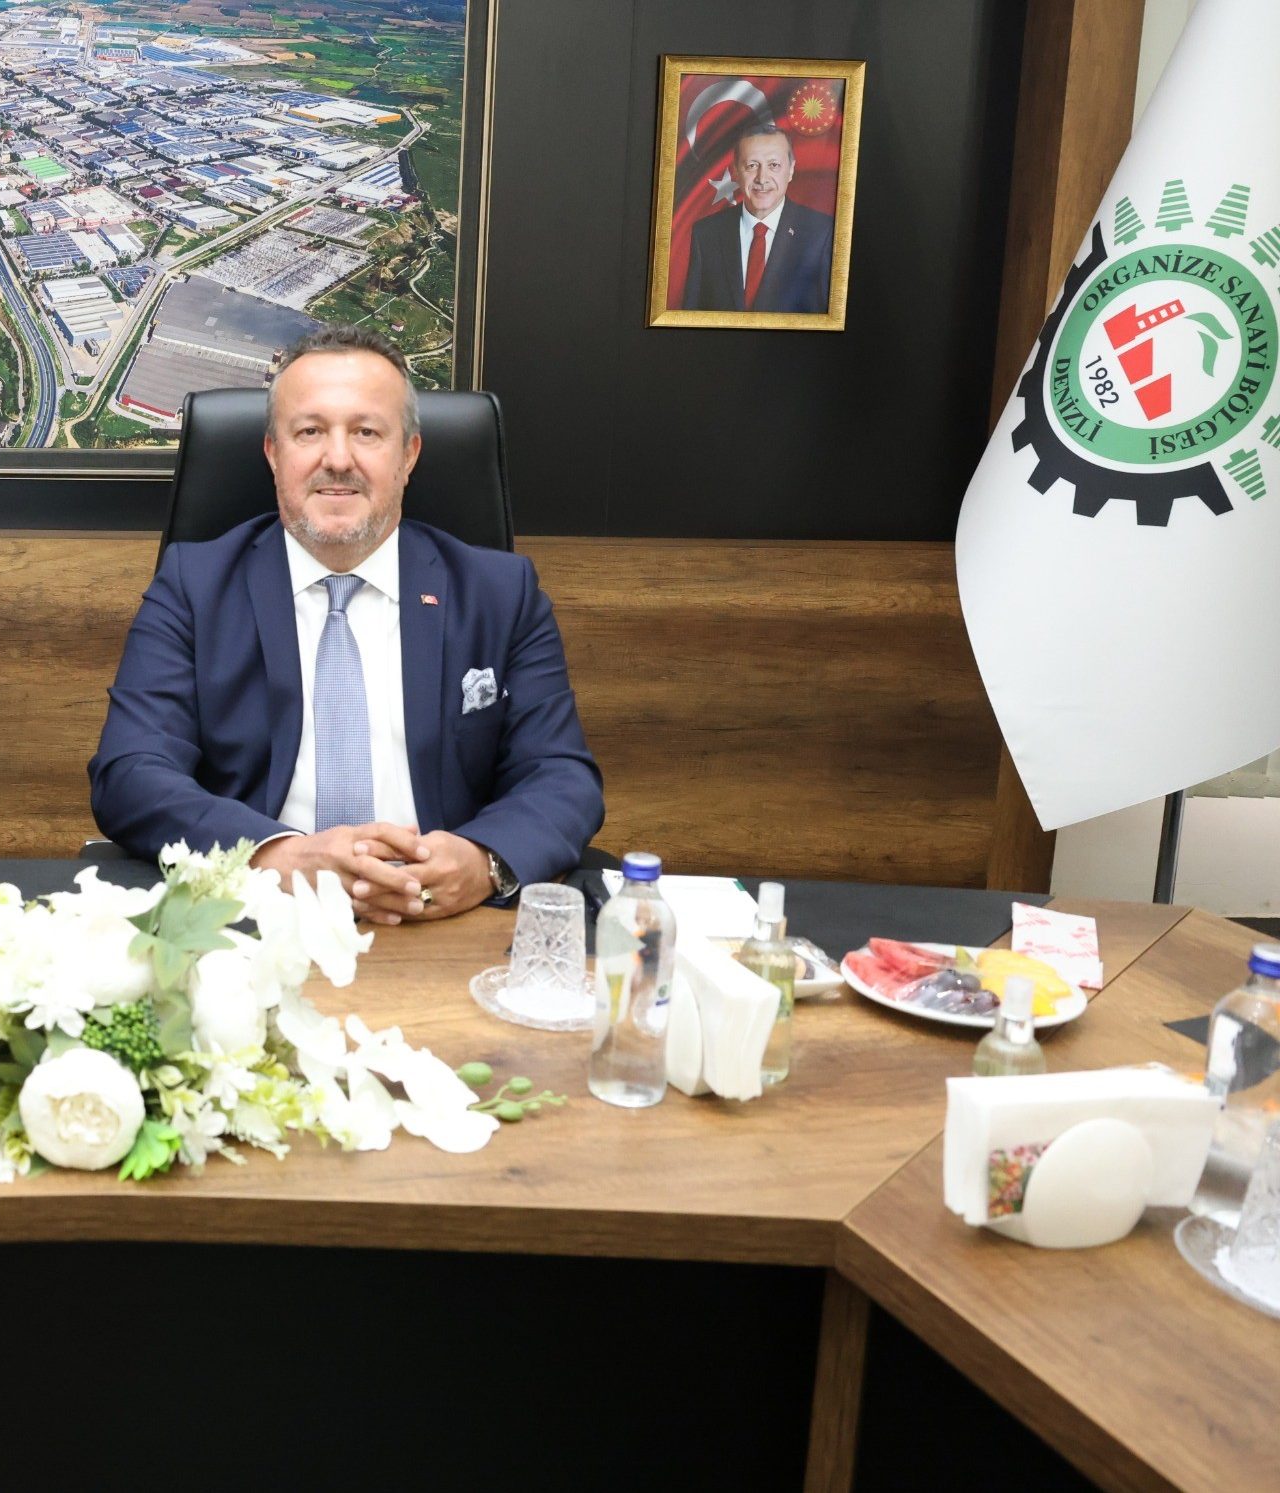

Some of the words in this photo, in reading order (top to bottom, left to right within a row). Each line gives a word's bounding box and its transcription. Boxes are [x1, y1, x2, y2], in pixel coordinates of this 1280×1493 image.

[1082, 250, 1223, 312] ORGANİZE
[1219, 275, 1270, 372] SANAYİ
[1053, 356, 1103, 443] DENİZLİ
[1085, 355, 1120, 409] 1982
[1149, 374, 1261, 460] BÖLGESİ
